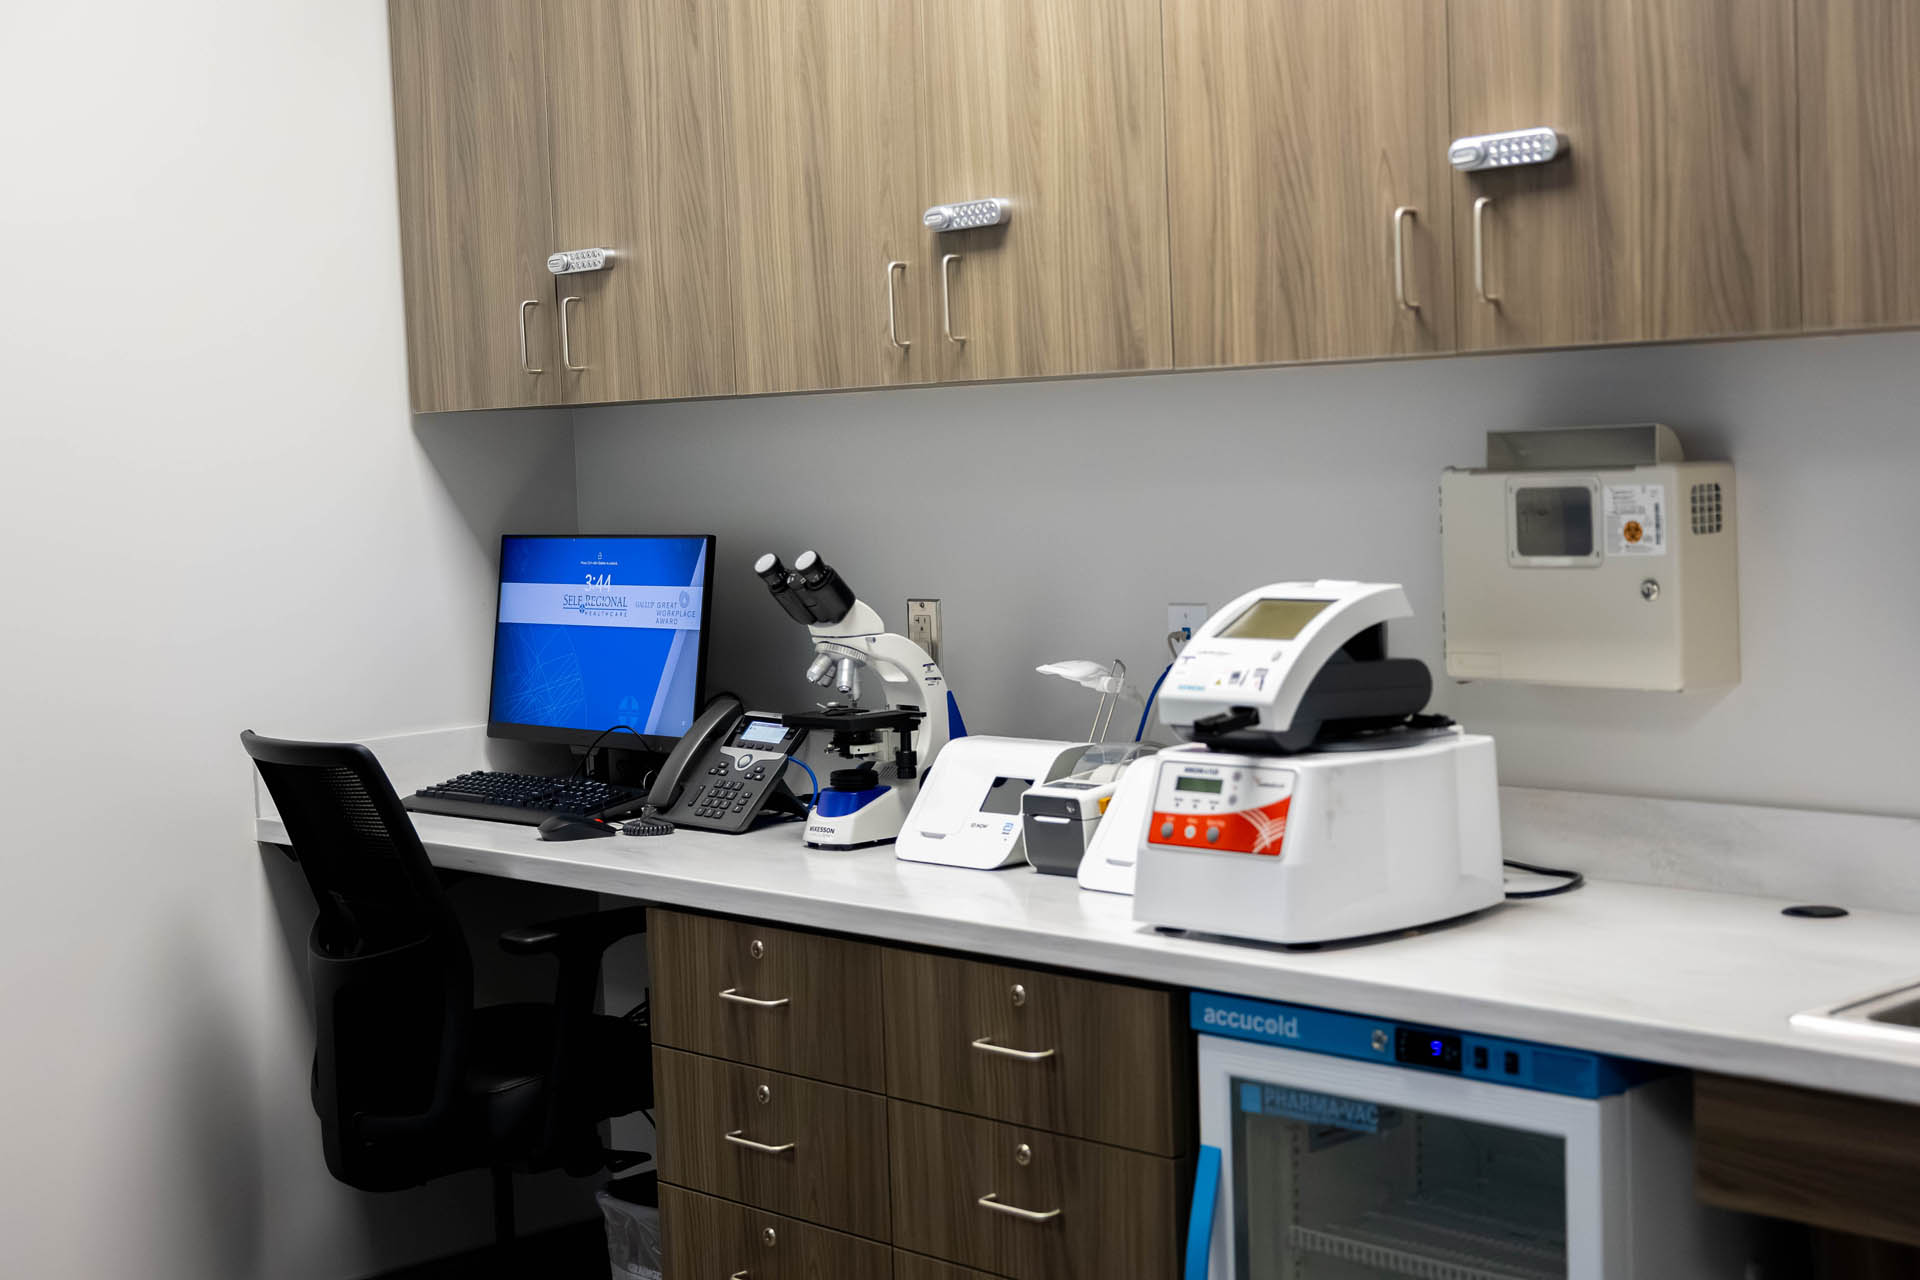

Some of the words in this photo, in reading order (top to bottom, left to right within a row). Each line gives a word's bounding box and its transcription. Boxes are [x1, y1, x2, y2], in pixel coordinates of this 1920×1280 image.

[585, 573, 611, 592] 3:44
[562, 594, 583, 606] SELF
[585, 594, 628, 608] REGIONAL
[656, 601, 677, 609] GREAT
[656, 609, 696, 618] WORKPLACE
[655, 617, 678, 625] AWARD
[1204, 1007, 1298, 1039] accucold
[1430, 1040, 1443, 1056] 9
